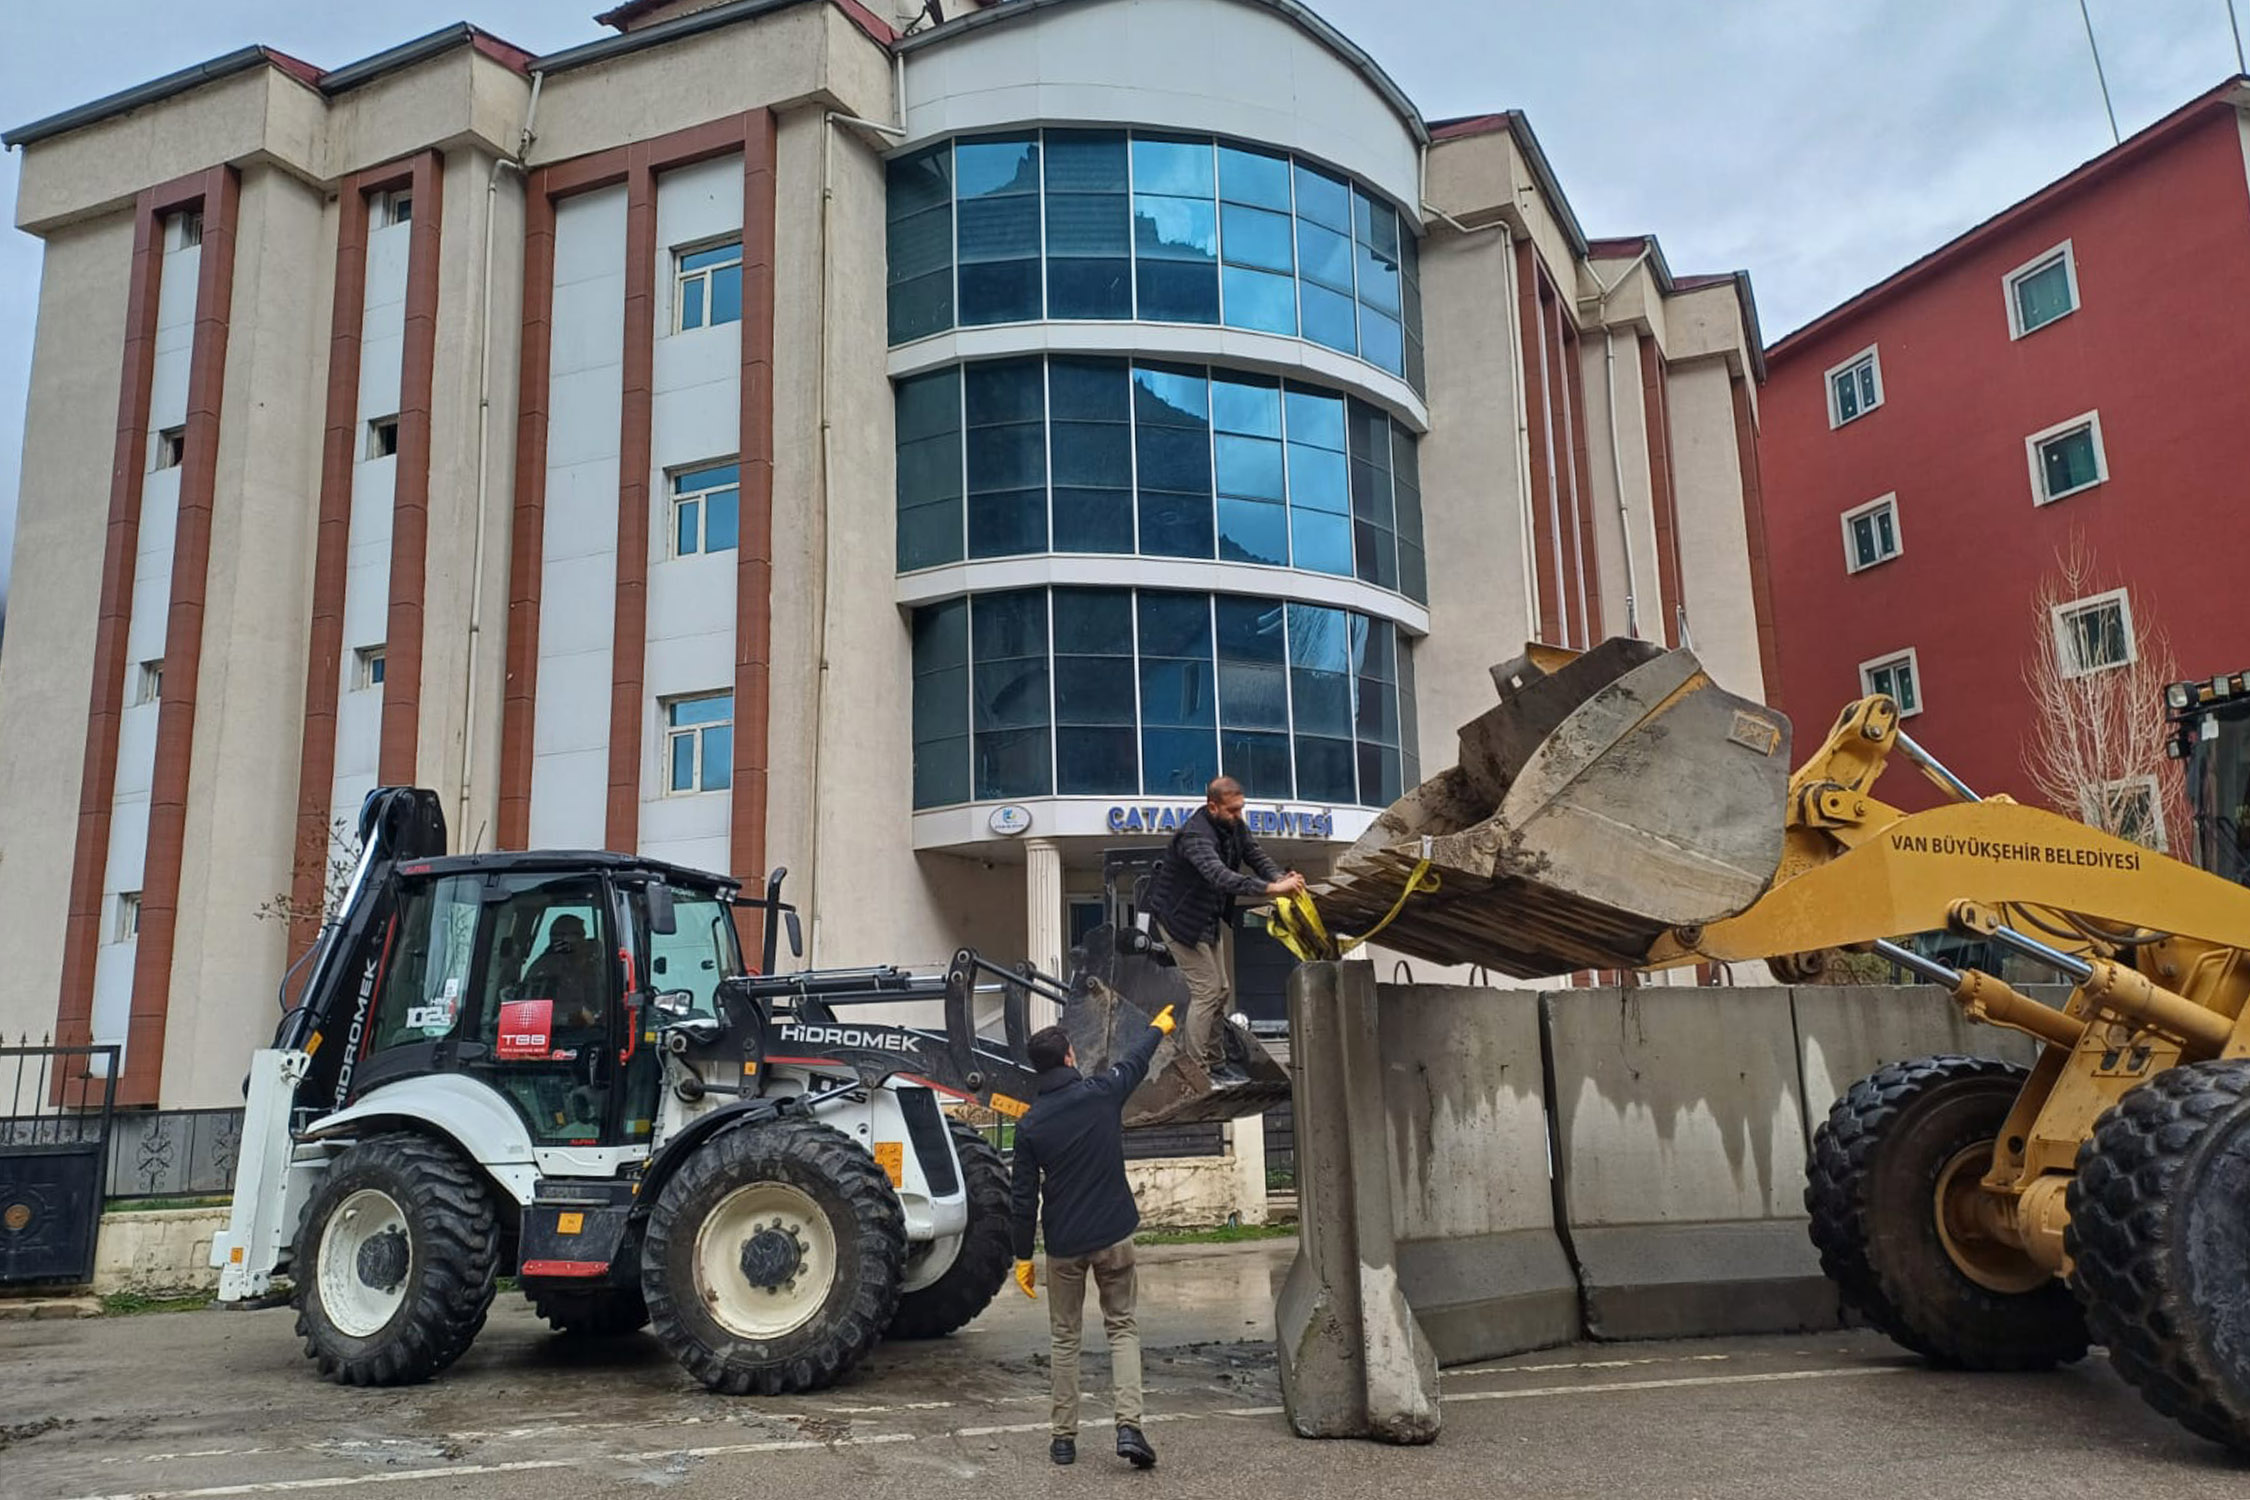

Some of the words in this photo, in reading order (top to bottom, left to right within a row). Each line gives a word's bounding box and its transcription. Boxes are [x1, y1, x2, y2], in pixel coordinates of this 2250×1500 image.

[1246, 808, 1334, 837] EDİYESİ
[1891, 835, 1927, 852] VAN
[1932, 835, 2041, 863] BÜYÜKŞEHİR
[2045, 848, 2140, 871] BELEDİYESİ
